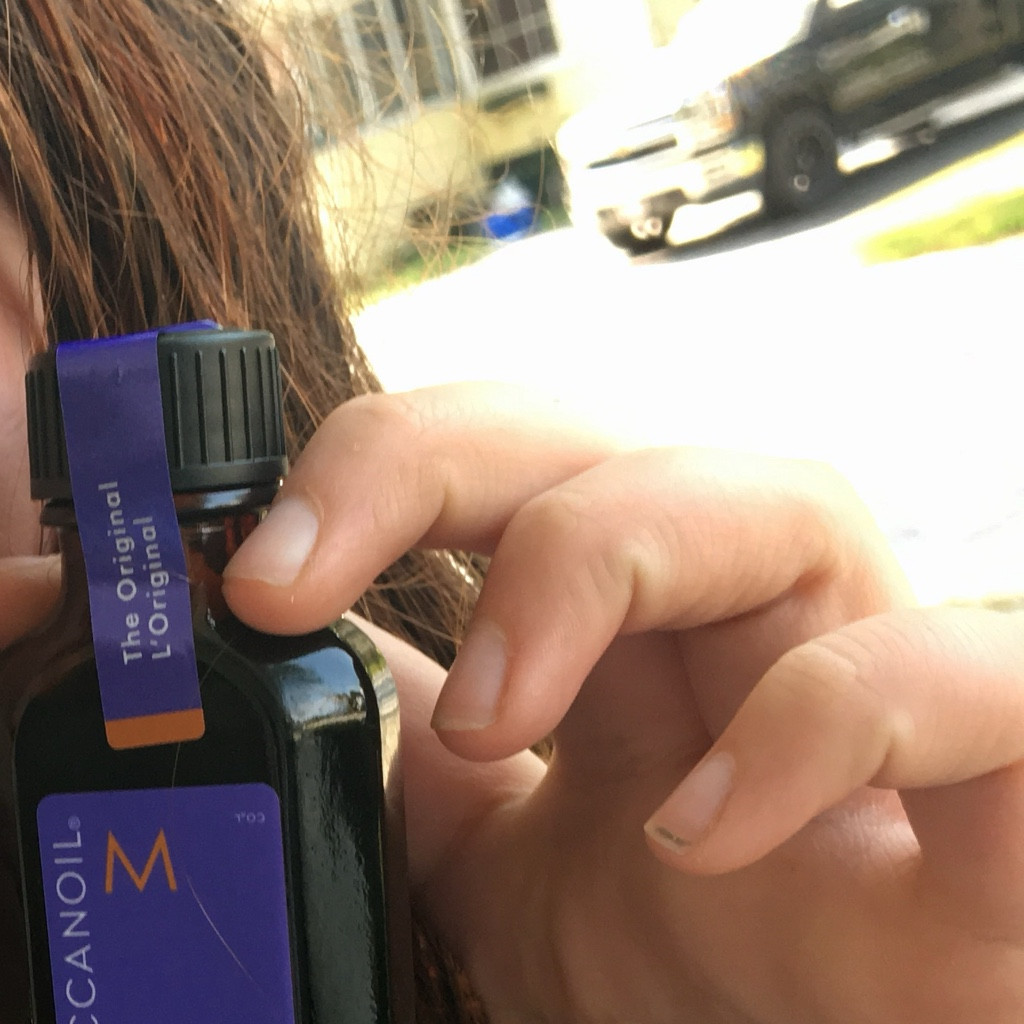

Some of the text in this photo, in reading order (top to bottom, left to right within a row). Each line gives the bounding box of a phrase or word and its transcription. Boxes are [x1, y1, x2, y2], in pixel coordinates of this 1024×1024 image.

[98, 481, 143, 665] The Original
[104, 827, 177, 894] M
